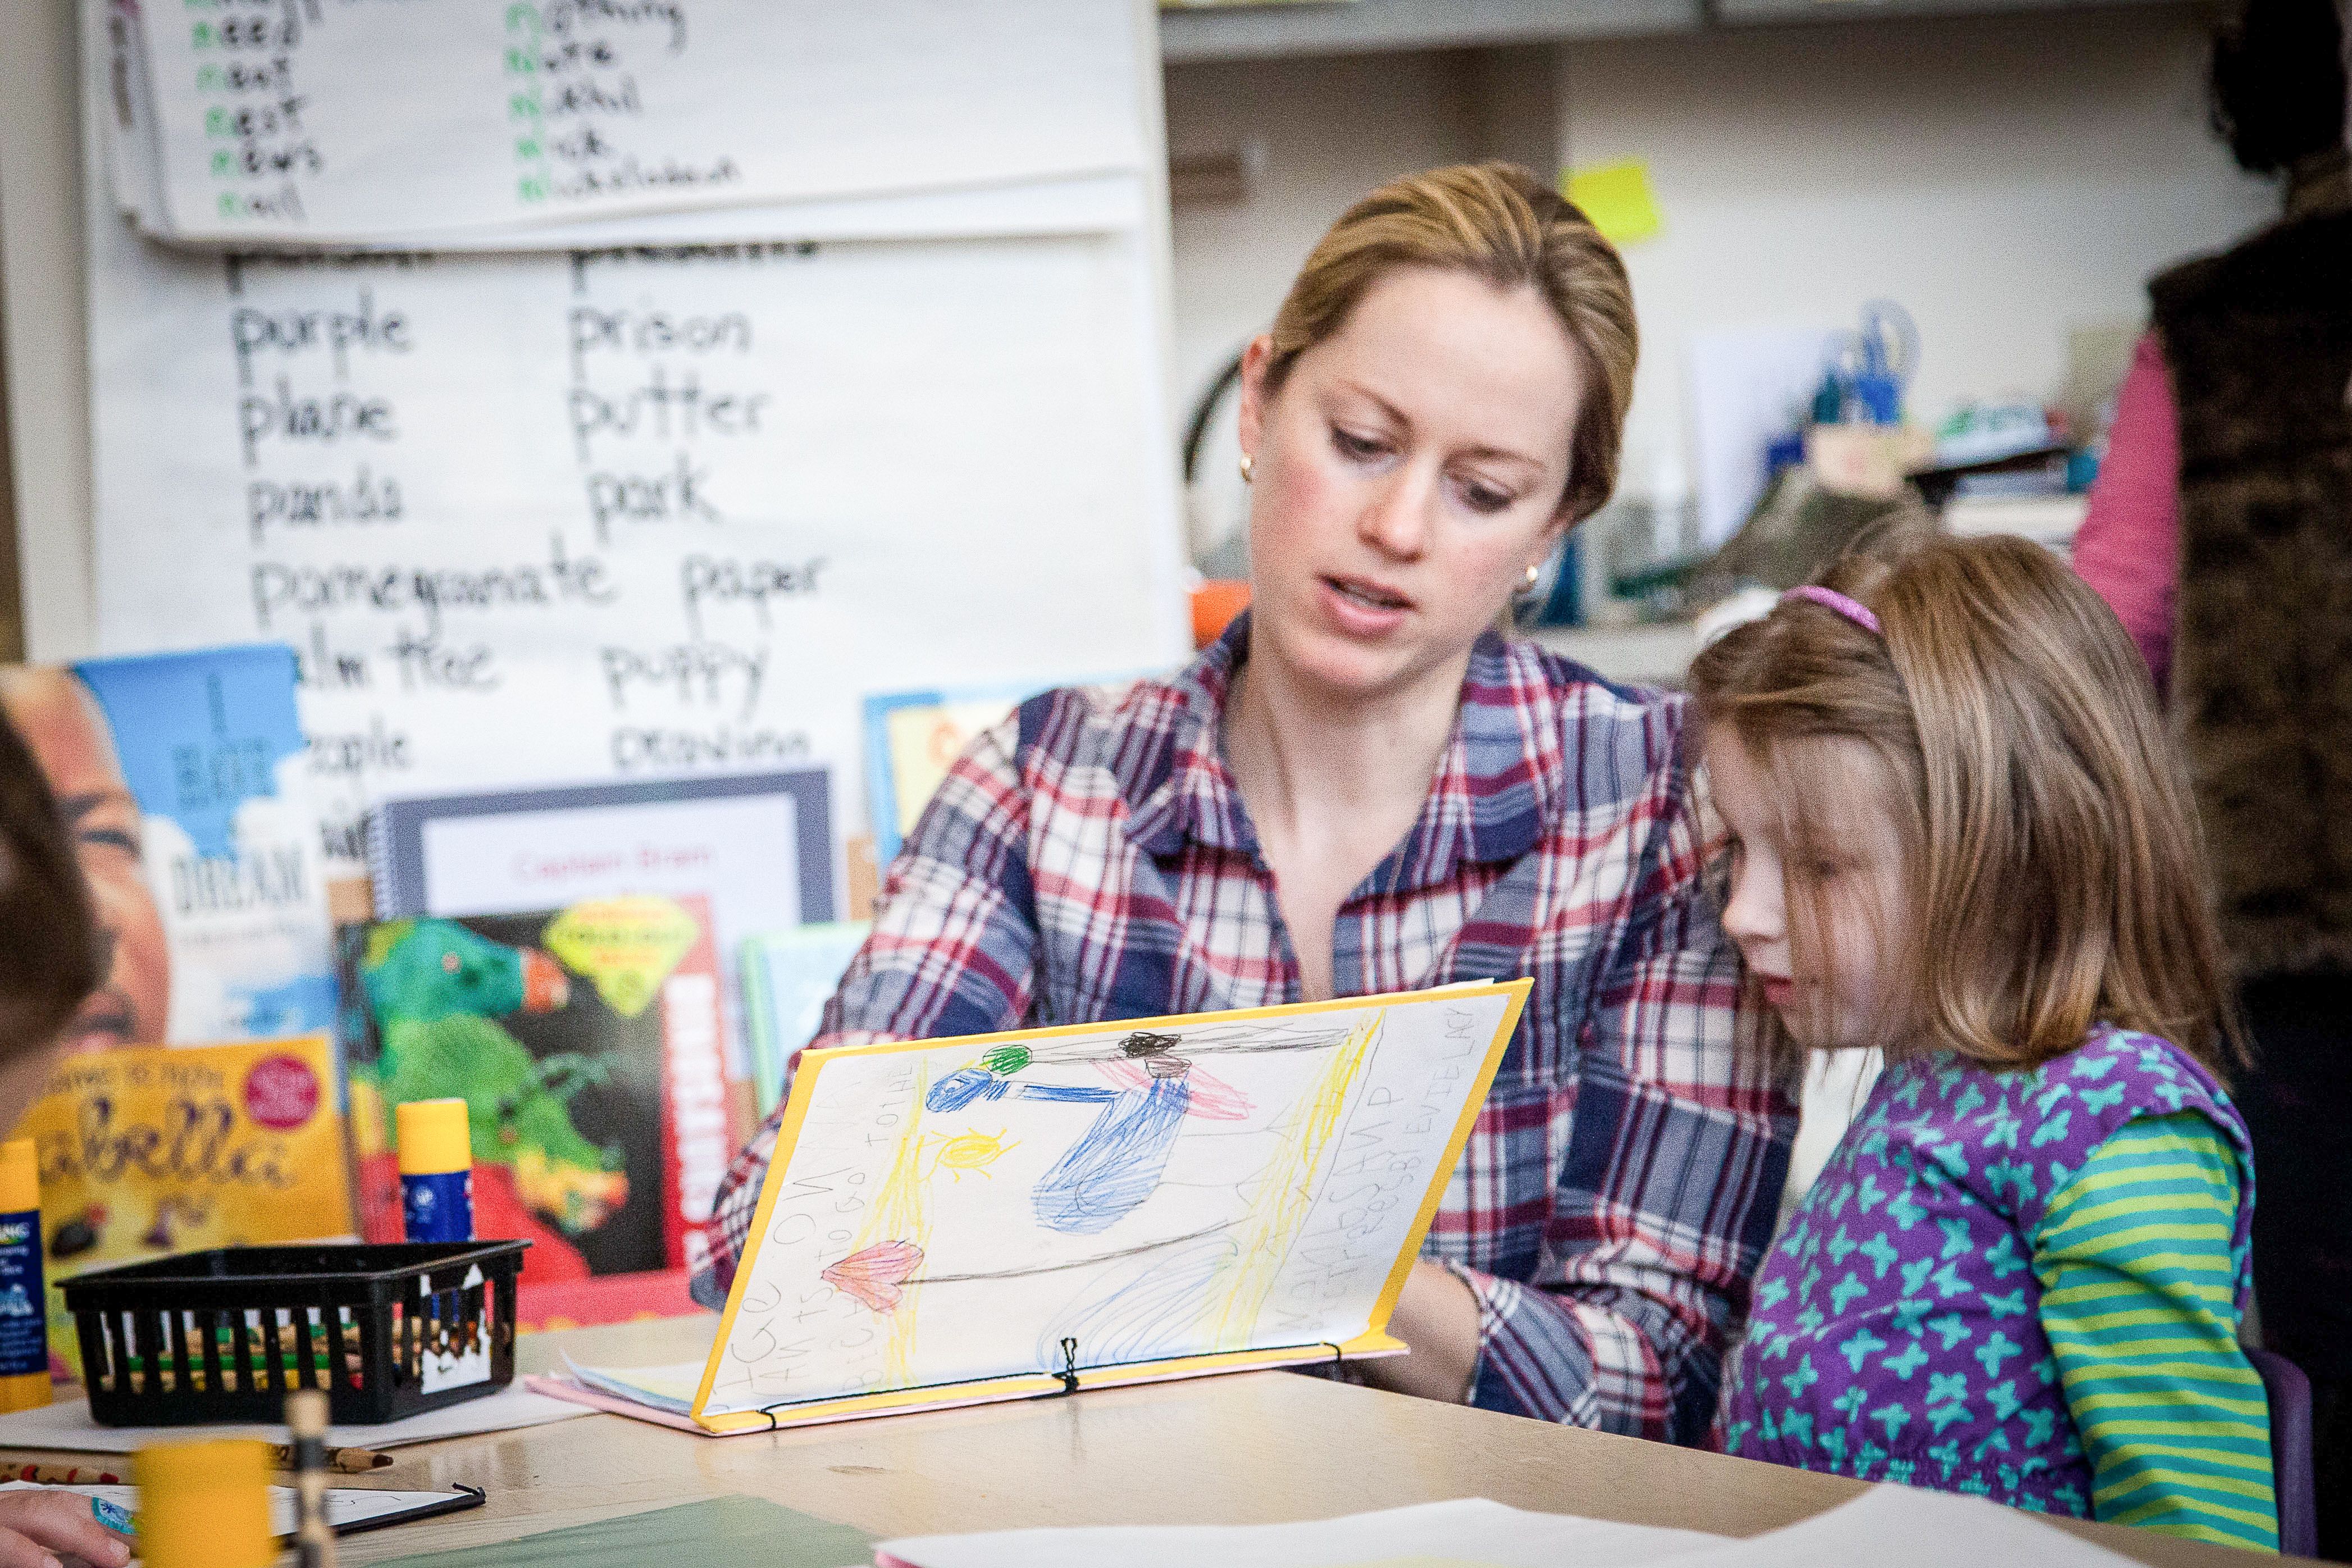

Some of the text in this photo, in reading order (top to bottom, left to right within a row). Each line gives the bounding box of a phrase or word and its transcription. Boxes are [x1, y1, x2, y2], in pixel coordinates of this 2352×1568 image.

[230, 285, 413, 385] purple
[567, 293, 754, 382] prison
[237, 373, 399, 467] plane
[567, 364, 771, 462] putter
[247, 461, 404, 546] panda
[587, 450, 724, 546] park
[679, 555, 827, 639] paper
[600, 642, 769, 722] puppy
